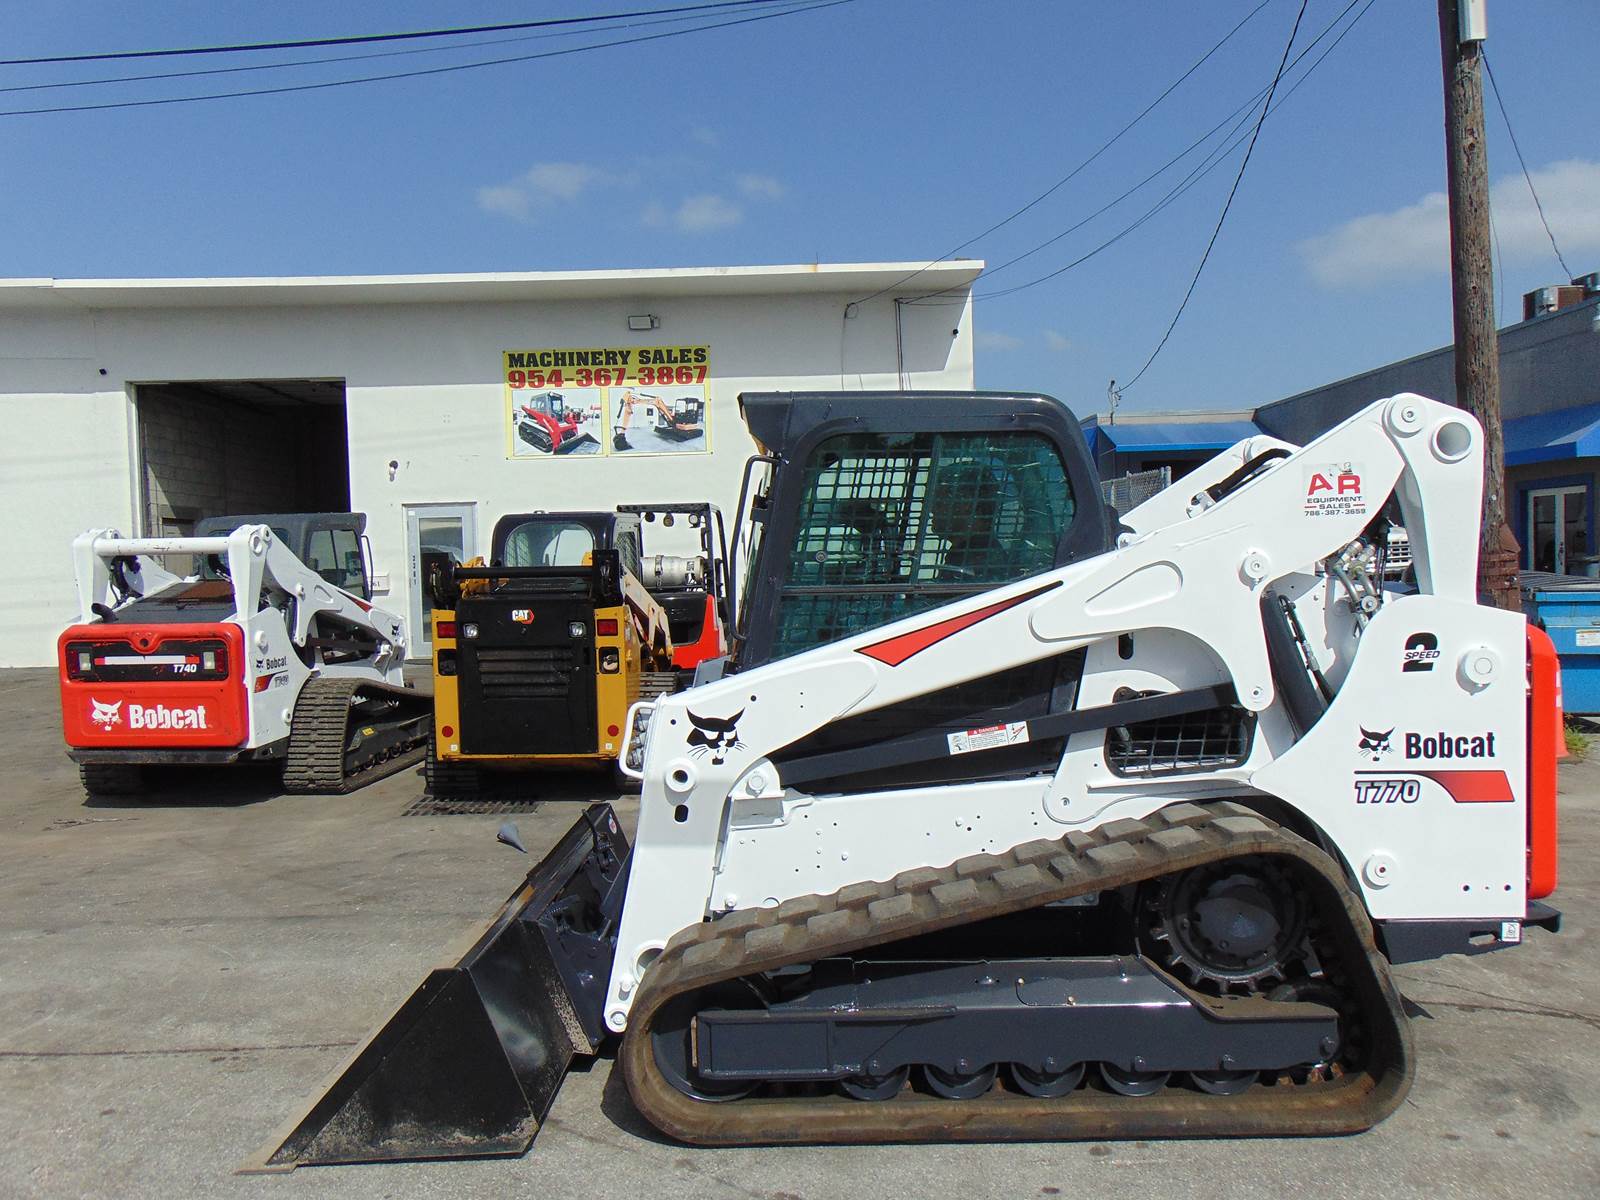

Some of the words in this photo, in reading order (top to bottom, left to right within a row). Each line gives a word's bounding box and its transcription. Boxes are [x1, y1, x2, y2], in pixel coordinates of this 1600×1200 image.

[508, 351, 631, 367] MACHINERY
[638, 348, 707, 364] SALES
[508, 365, 707, 388] 954-367-3867
[1306, 496, 1362, 504] EQUIPMENT
[512, 609, 529, 622] CAT
[1402, 632, 1438, 673] 2
[1404, 650, 1440, 660] SPEED
[173, 664, 196, 673] T740
[266, 656, 287, 670] Bobcat
[129, 704, 207, 729] Bobcat
[1405, 732, 1495, 759] Bobcat
[1355, 780, 1420, 803] T770
